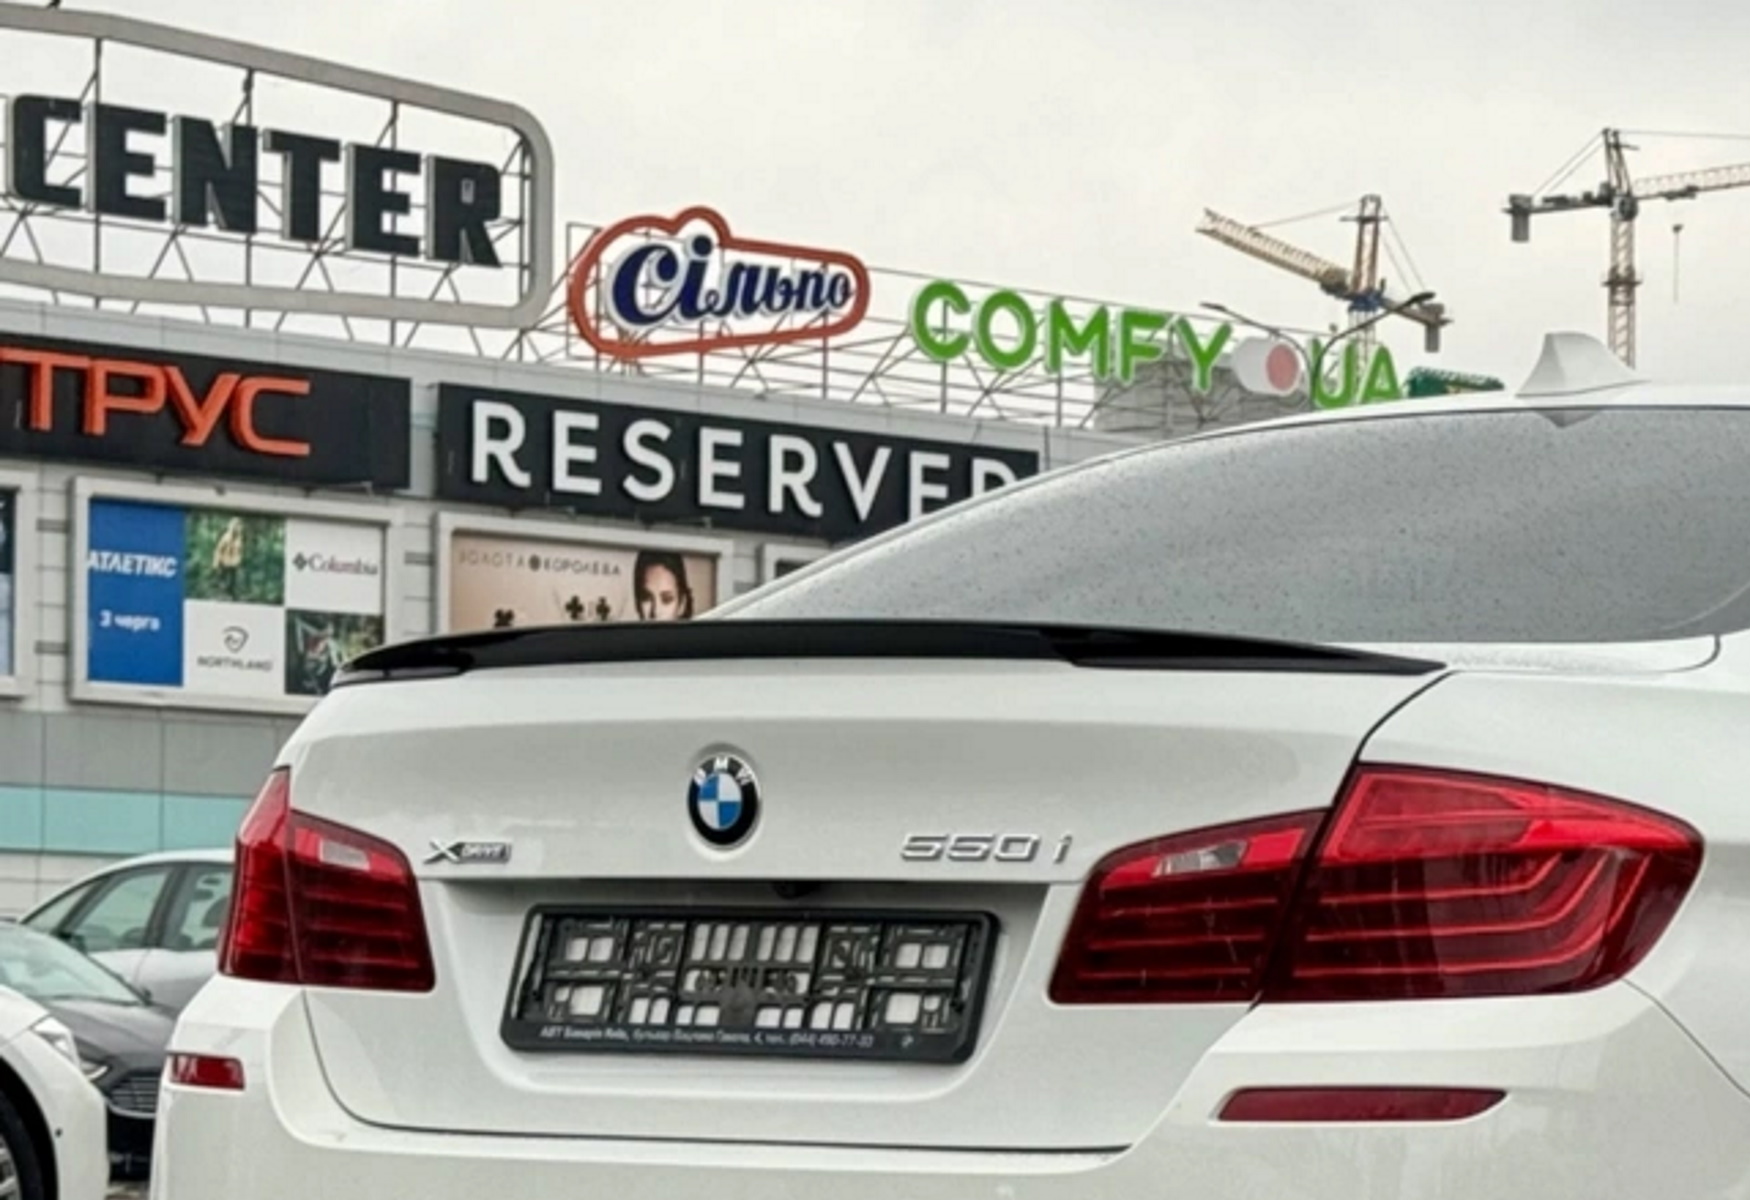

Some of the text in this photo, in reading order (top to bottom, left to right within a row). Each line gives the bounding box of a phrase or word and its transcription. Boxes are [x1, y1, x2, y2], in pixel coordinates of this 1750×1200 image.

[6, 94, 501, 268] CENTER
[611, 234, 852, 326] Сільпо
[909, 279, 1233, 394] COMFY
[307, 552, 379, 576] Columbia
[197, 656, 273, 671] NORTHLAND
